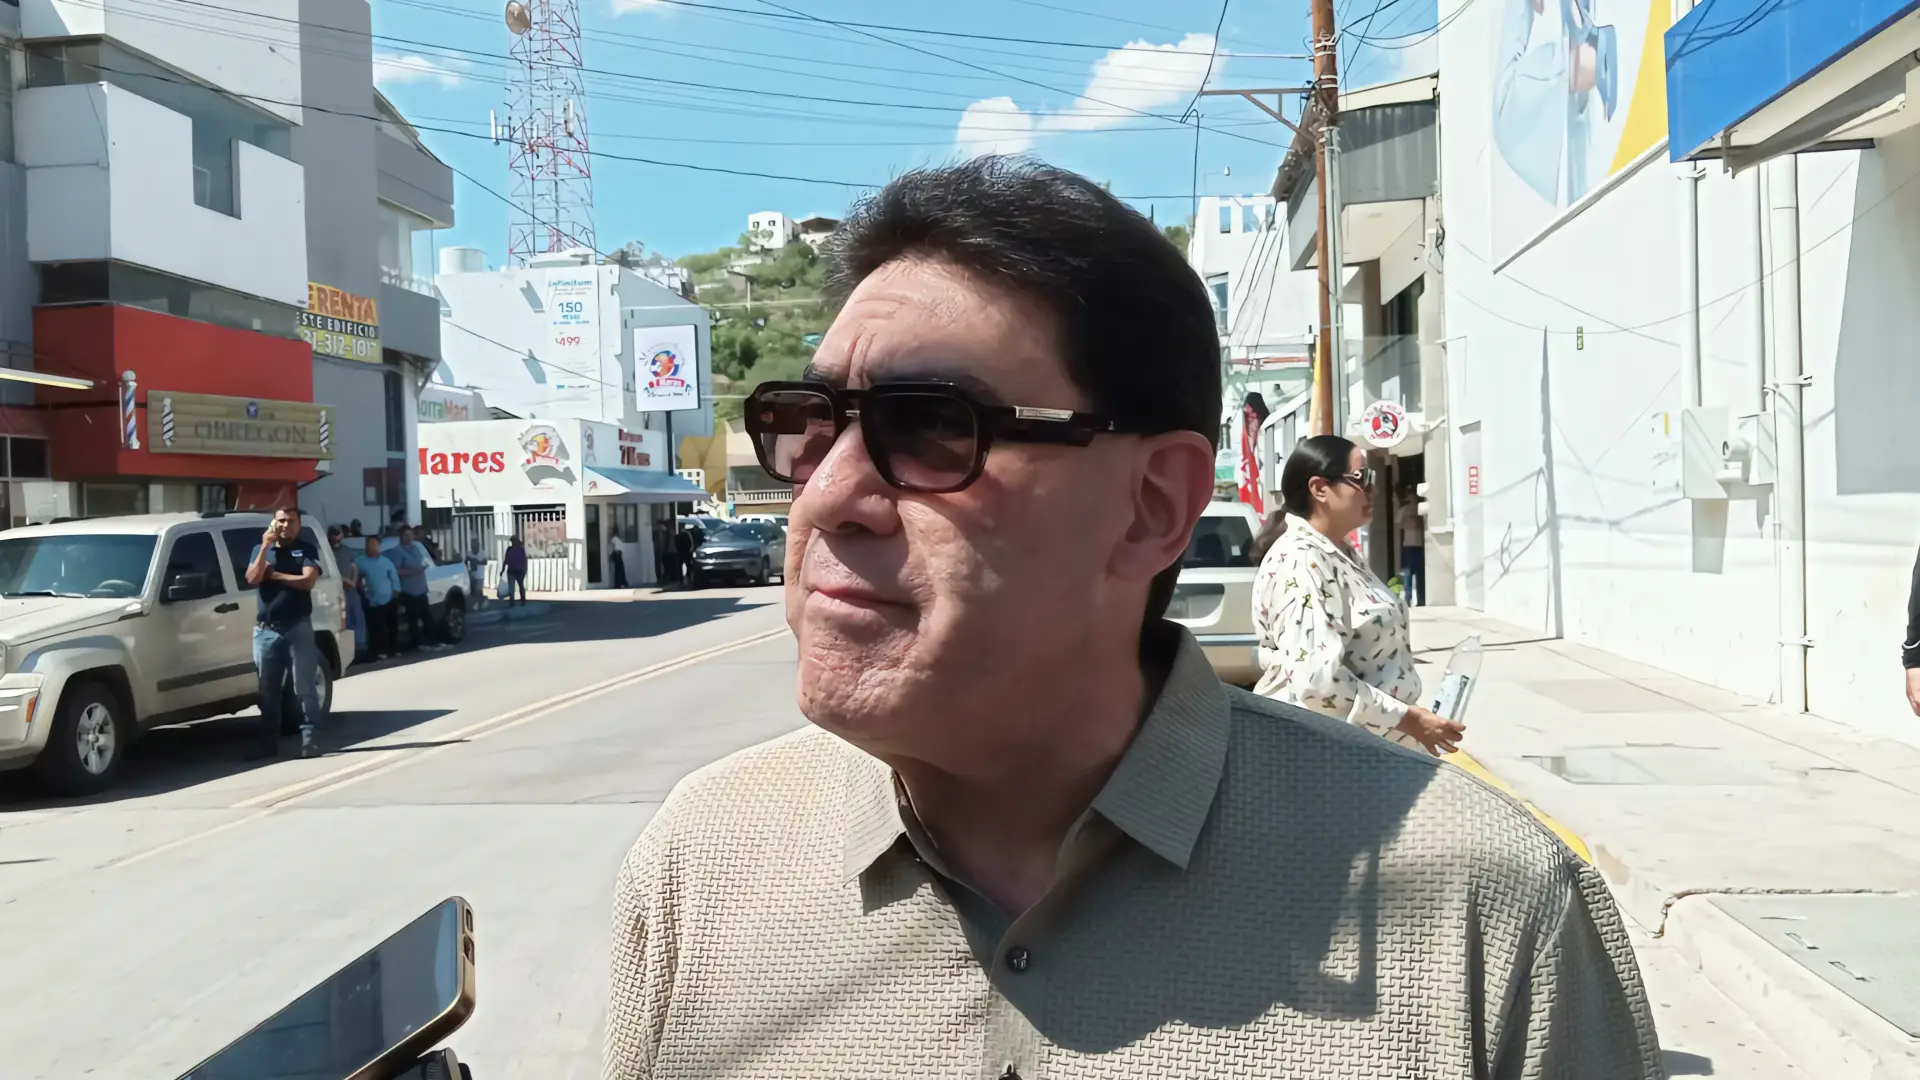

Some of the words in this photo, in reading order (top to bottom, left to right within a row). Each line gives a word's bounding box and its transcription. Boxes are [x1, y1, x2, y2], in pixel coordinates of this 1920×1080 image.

[317, 286, 377, 326] RENTA
[558, 301, 583, 313] 150
[327, 318, 375, 338] EDIFICIO
